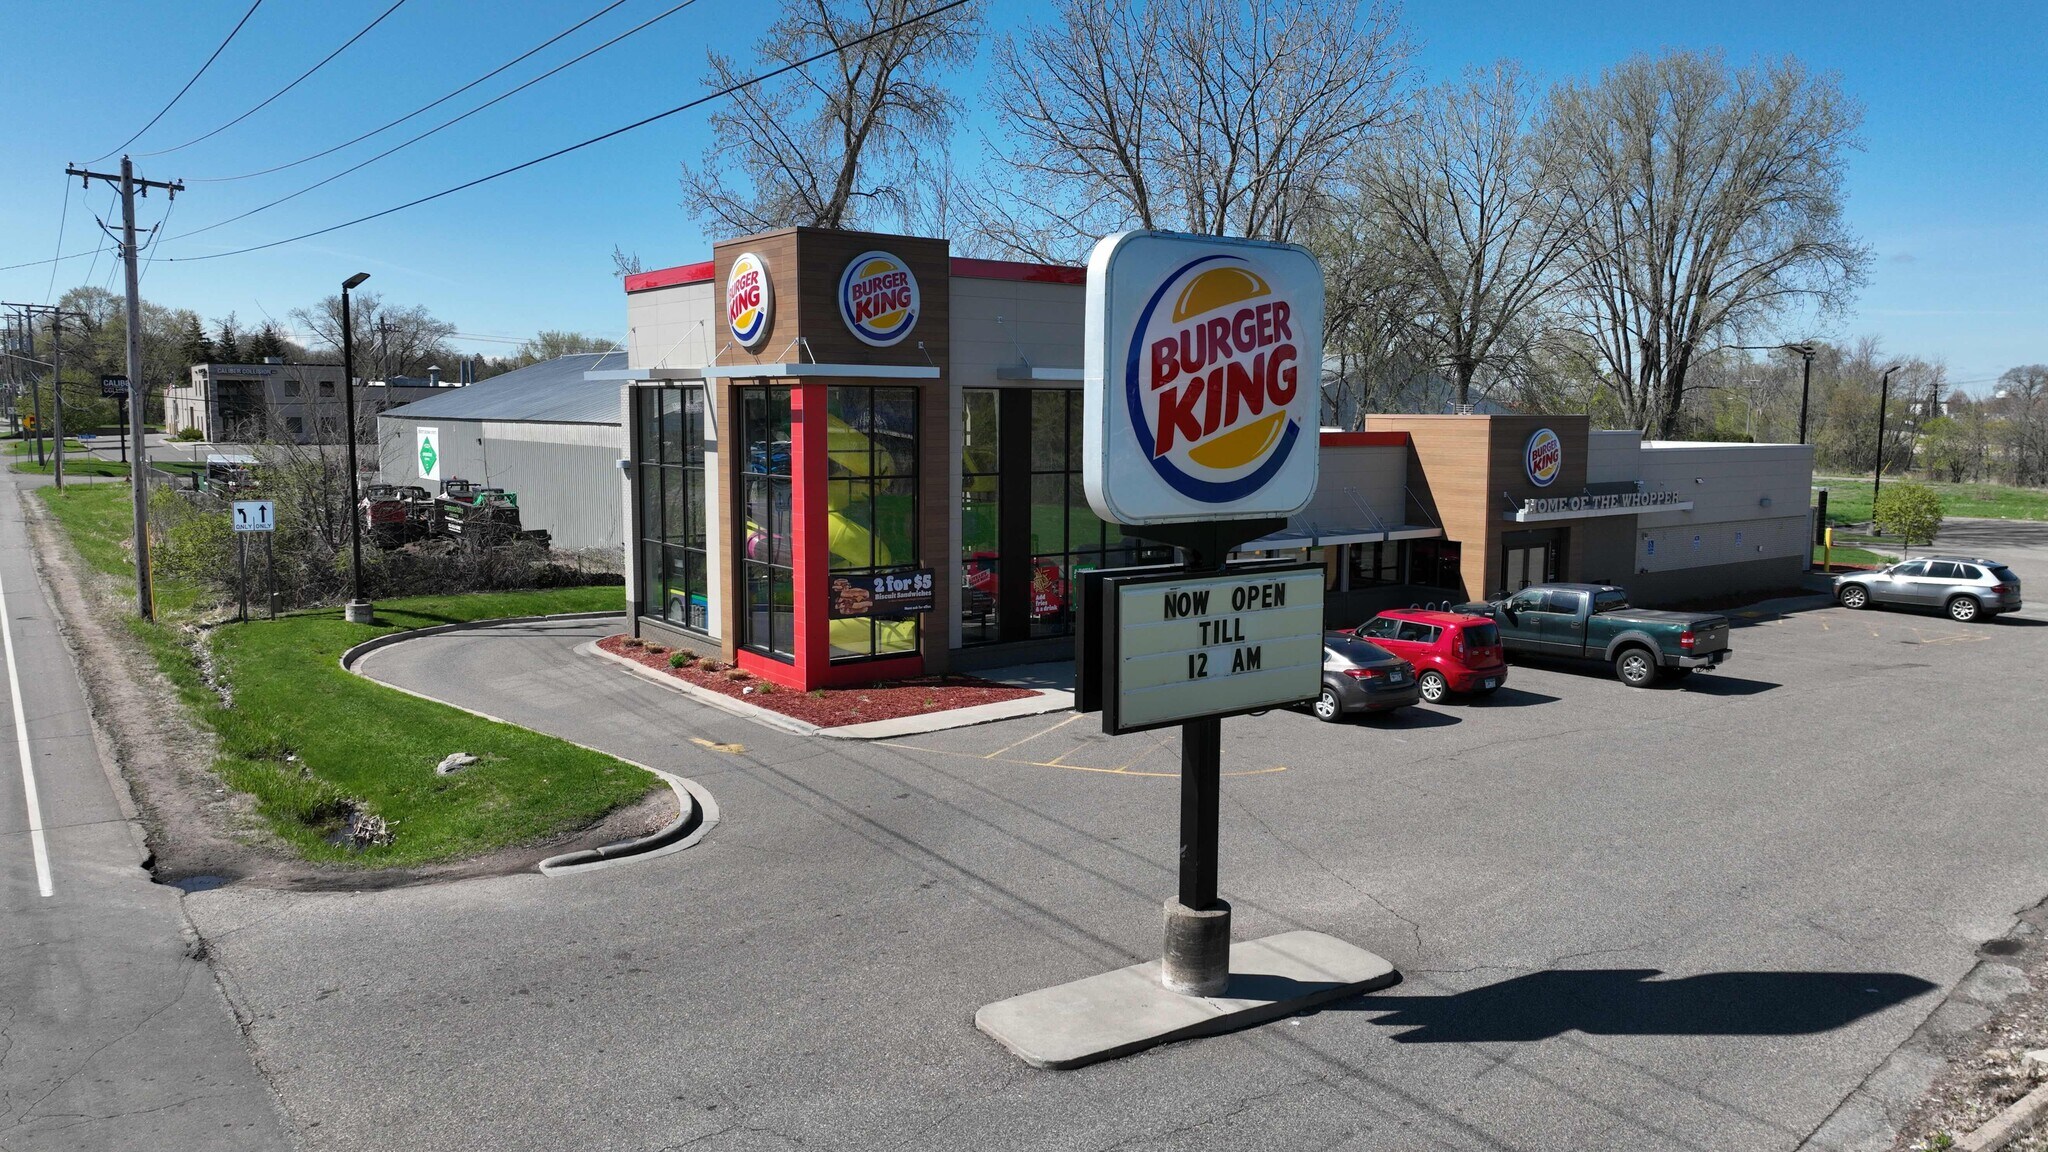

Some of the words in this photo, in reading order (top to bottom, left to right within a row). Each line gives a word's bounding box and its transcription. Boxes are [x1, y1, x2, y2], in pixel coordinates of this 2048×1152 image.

[728, 270, 759, 300] BURGER
[852, 271, 908, 299] BURGER
[729, 285, 760, 324] KING
[855, 287, 911, 324] KING
[1151, 300, 1292, 391] BURGER
[1154, 343, 1298, 460] KING
[1532, 439, 1557, 460] BURGER
[1532, 449, 1559, 476] KING
[1525, 497, 1568, 514] HOME
[1570, 495, 1589, 511] OF
[1593, 494, 1618, 509] THE
[1621, 491, 1680, 508] WHOPPER
[873, 577, 885, 593] 2
[886, 575, 912, 592] for
[913, 574, 932, 591] $5
[875, 592, 897, 600] Biscuit
[897, 589, 932, 599] Sandwiches
[1035, 593, 1046, 601] Add
[1043, 604, 1058, 612] drink
[1164, 590, 1210, 619] NOW
[1231, 583, 1286, 612] OPEN
[1199, 618, 1245, 646] TILL
[1188, 652, 1208, 679] 12
[1232, 646, 1261, 673] AM
